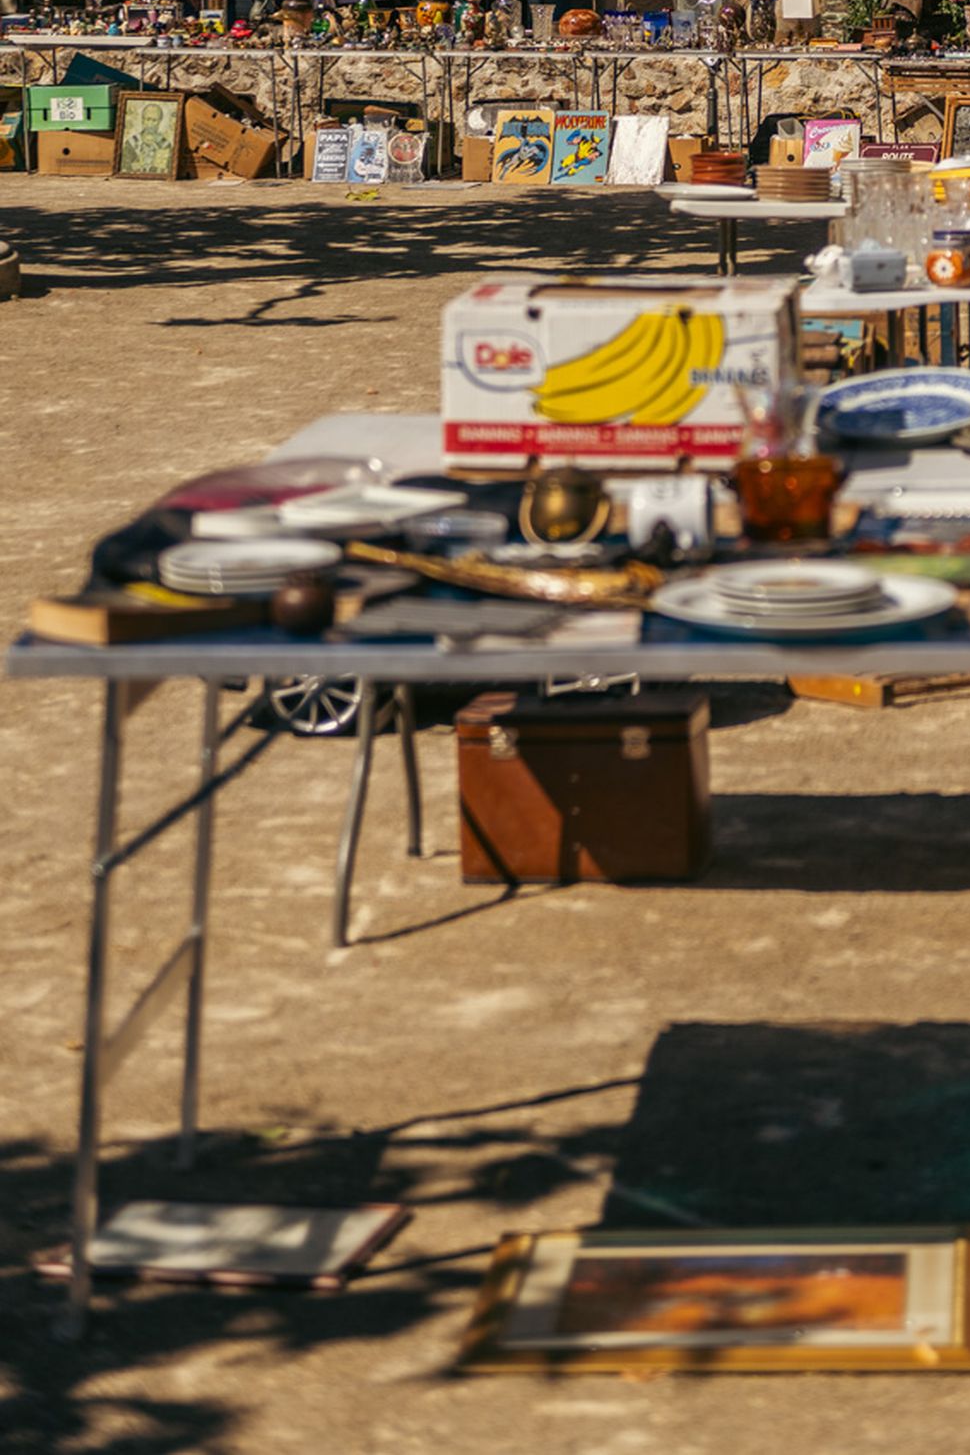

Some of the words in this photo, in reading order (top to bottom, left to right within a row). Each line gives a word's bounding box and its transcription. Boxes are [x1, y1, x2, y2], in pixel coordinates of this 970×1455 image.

[555, 115, 607, 130] WOLVERINE
[319, 134, 348, 142] PAPA
[881, 152, 915, 160] ROUTE
[474, 342, 533, 369] Dole
